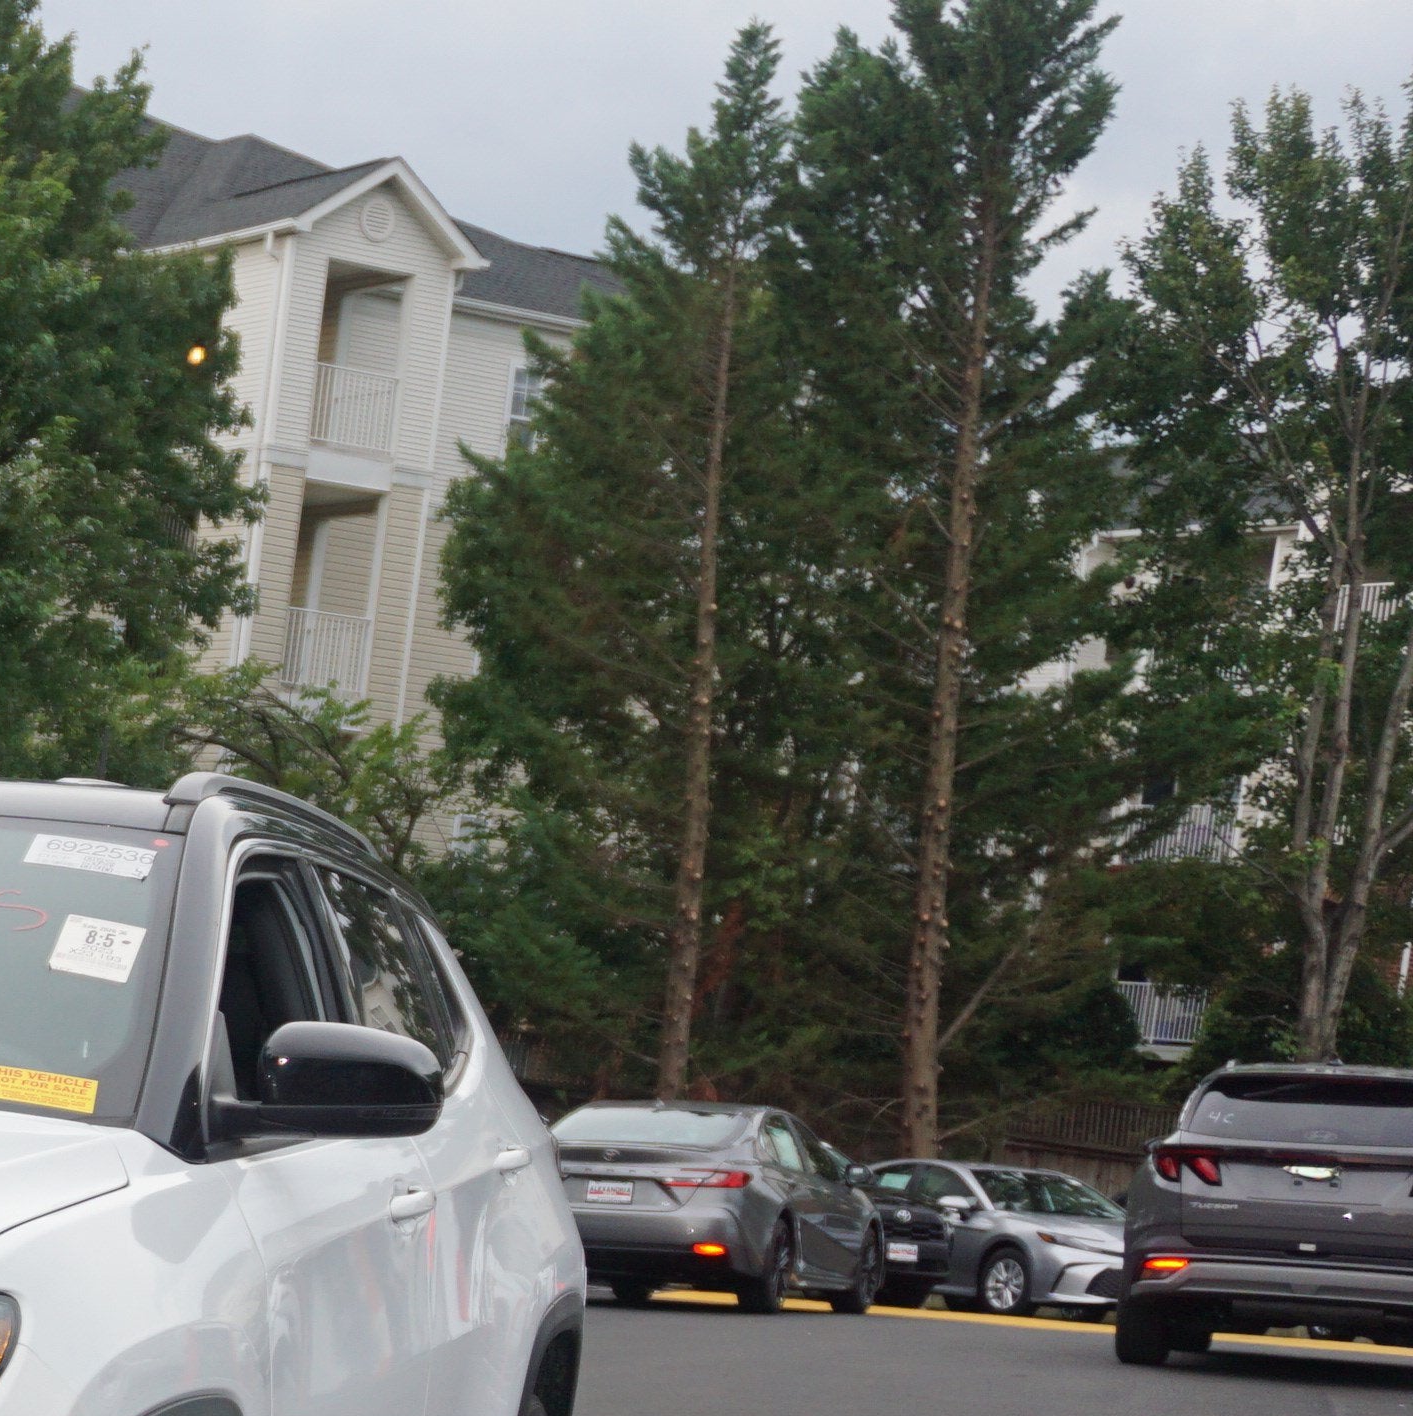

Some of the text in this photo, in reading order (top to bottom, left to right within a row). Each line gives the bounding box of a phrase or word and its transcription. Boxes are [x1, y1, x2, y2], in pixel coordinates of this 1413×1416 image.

[46, 839, 156, 864] 6922536
[21, 1080, 49, 1089] FOR
[53, 1085, 88, 1095] SALE
[28, 1073, 92, 1089] VEHICLE
